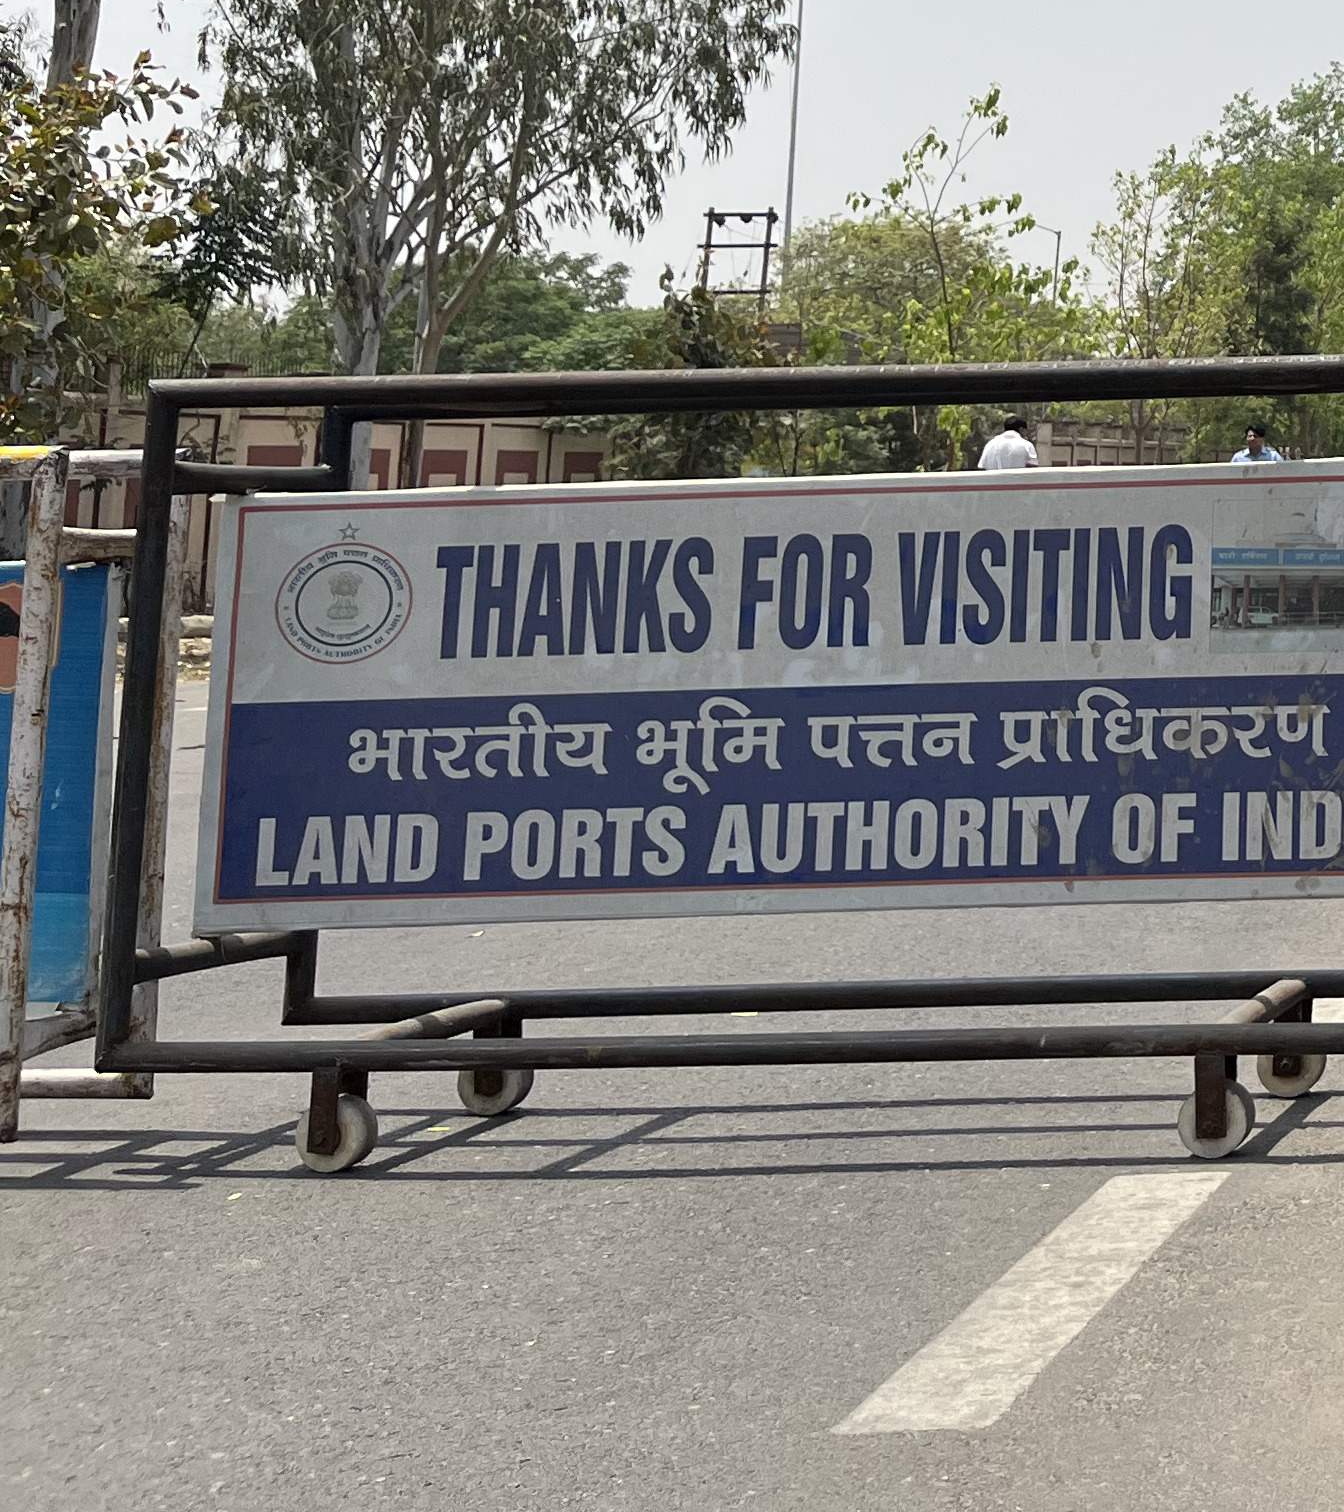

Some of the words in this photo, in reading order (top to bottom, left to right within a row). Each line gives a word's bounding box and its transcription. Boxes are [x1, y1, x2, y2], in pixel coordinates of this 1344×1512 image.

[436, 536, 713, 660] THANKS
[738, 531, 876, 651] FOR
[898, 523, 1192, 646] VISITING
[349, 701, 611, 783] भारतीय
[637, 696, 784, 795] भूमि
[808, 709, 976, 769] पत्तन
[999, 687, 1329, 771] प्राधिकरण
[256, 813, 441, 888] LAND
[464, 804, 688, 882] PORTS
[708, 794, 1095, 876] AUTHORITY
[1111, 791, 1198, 865] OF
